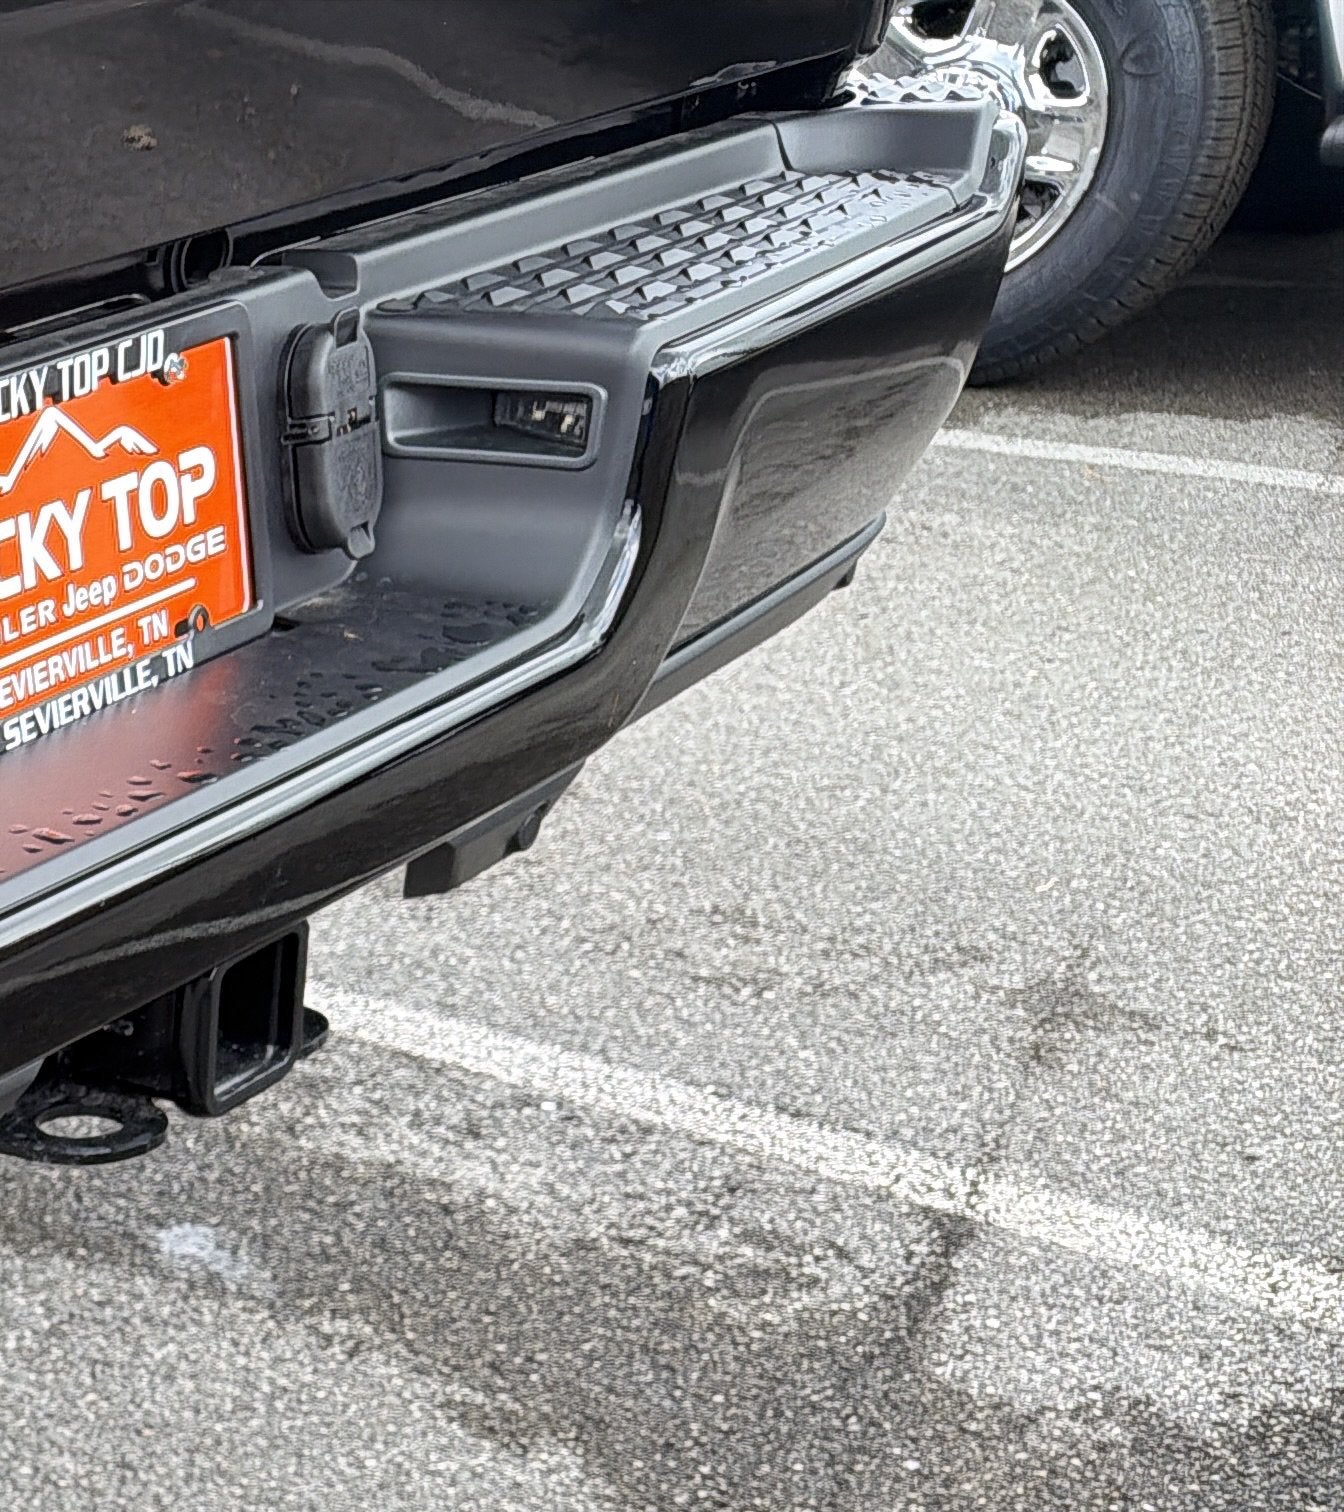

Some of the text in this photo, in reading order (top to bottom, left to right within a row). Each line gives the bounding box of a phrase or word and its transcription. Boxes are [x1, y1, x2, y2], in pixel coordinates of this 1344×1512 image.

[57, 347, 109, 399] TOP
[116, 329, 165, 382] CJD
[102, 446, 216, 553] TOP
[62, 574, 116, 619] Jeep
[122, 525, 226, 592] DODGE
[138, 609, 170, 645] TN
[3, 640, 194, 751] SEVIERVILLE, TN
